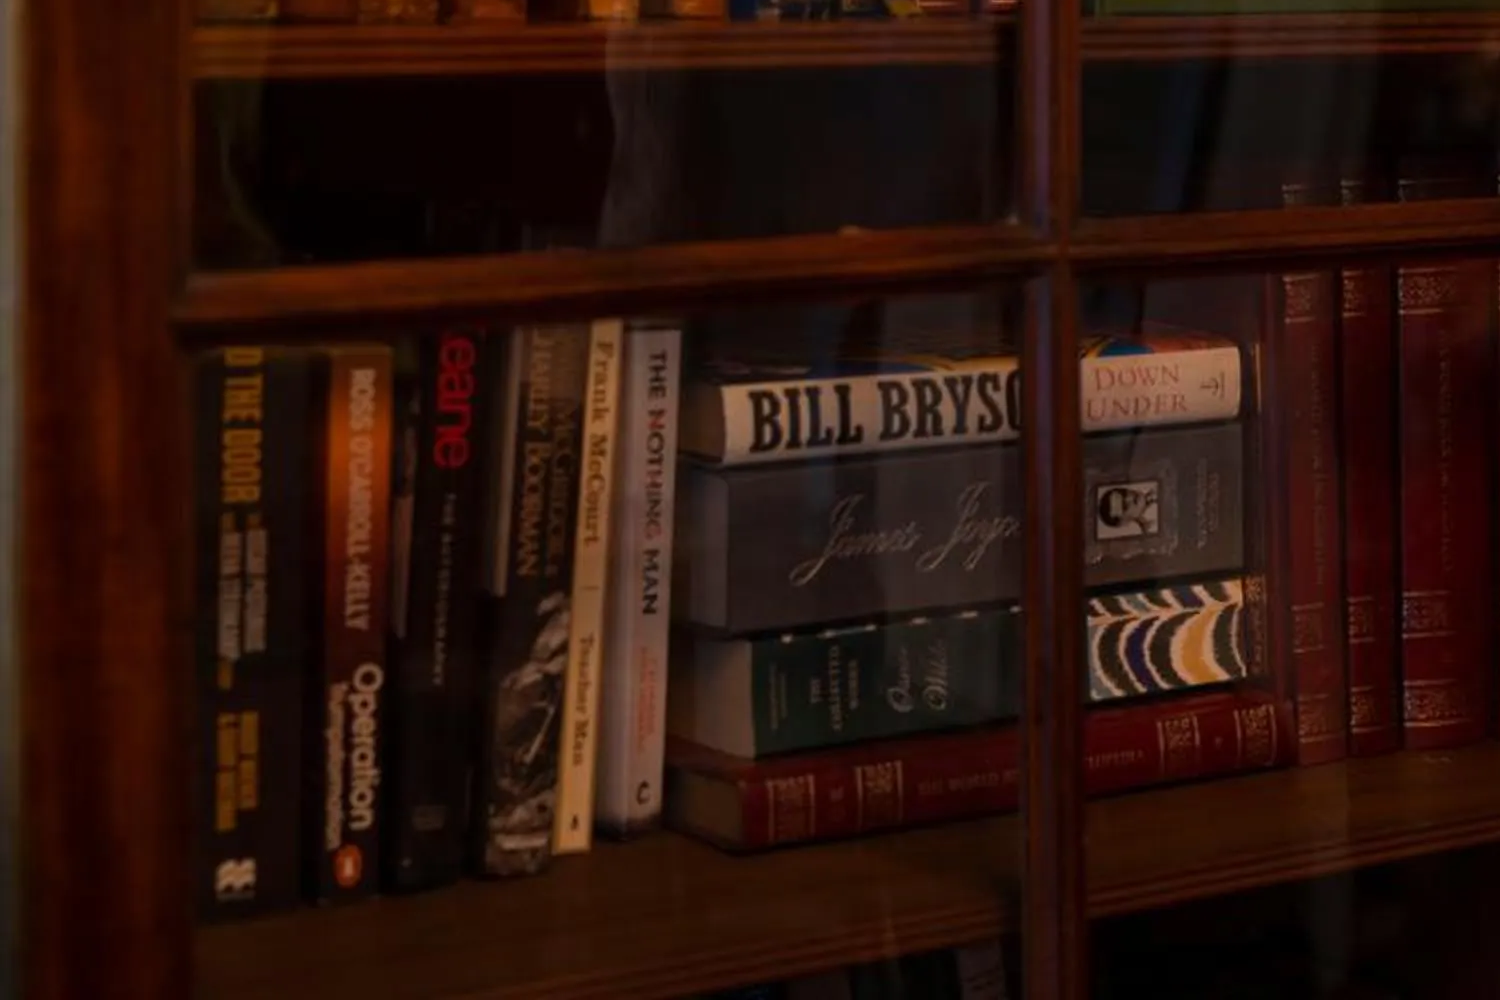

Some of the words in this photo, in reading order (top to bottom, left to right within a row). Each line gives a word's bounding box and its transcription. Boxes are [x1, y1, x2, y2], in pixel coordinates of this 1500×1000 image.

[222, 374, 265, 423] THE
[350, 368, 377, 431] ROSS
[589, 340, 616, 423] Frank
[647, 350, 669, 401] THE
[1086, 393, 1188, 421] UNDER
[1094, 364, 1180, 391] DOWN
[748, 384, 862, 451] BILL
[220, 429, 264, 504] DOOR
[582, 434, 609, 547] McCourt
[641, 409, 667, 541] NOTHING
[788, 492, 923, 586] James
[641, 548, 660, 615] MAN
[348, 661, 386, 832] Operation
[572, 719, 591, 767] Man
